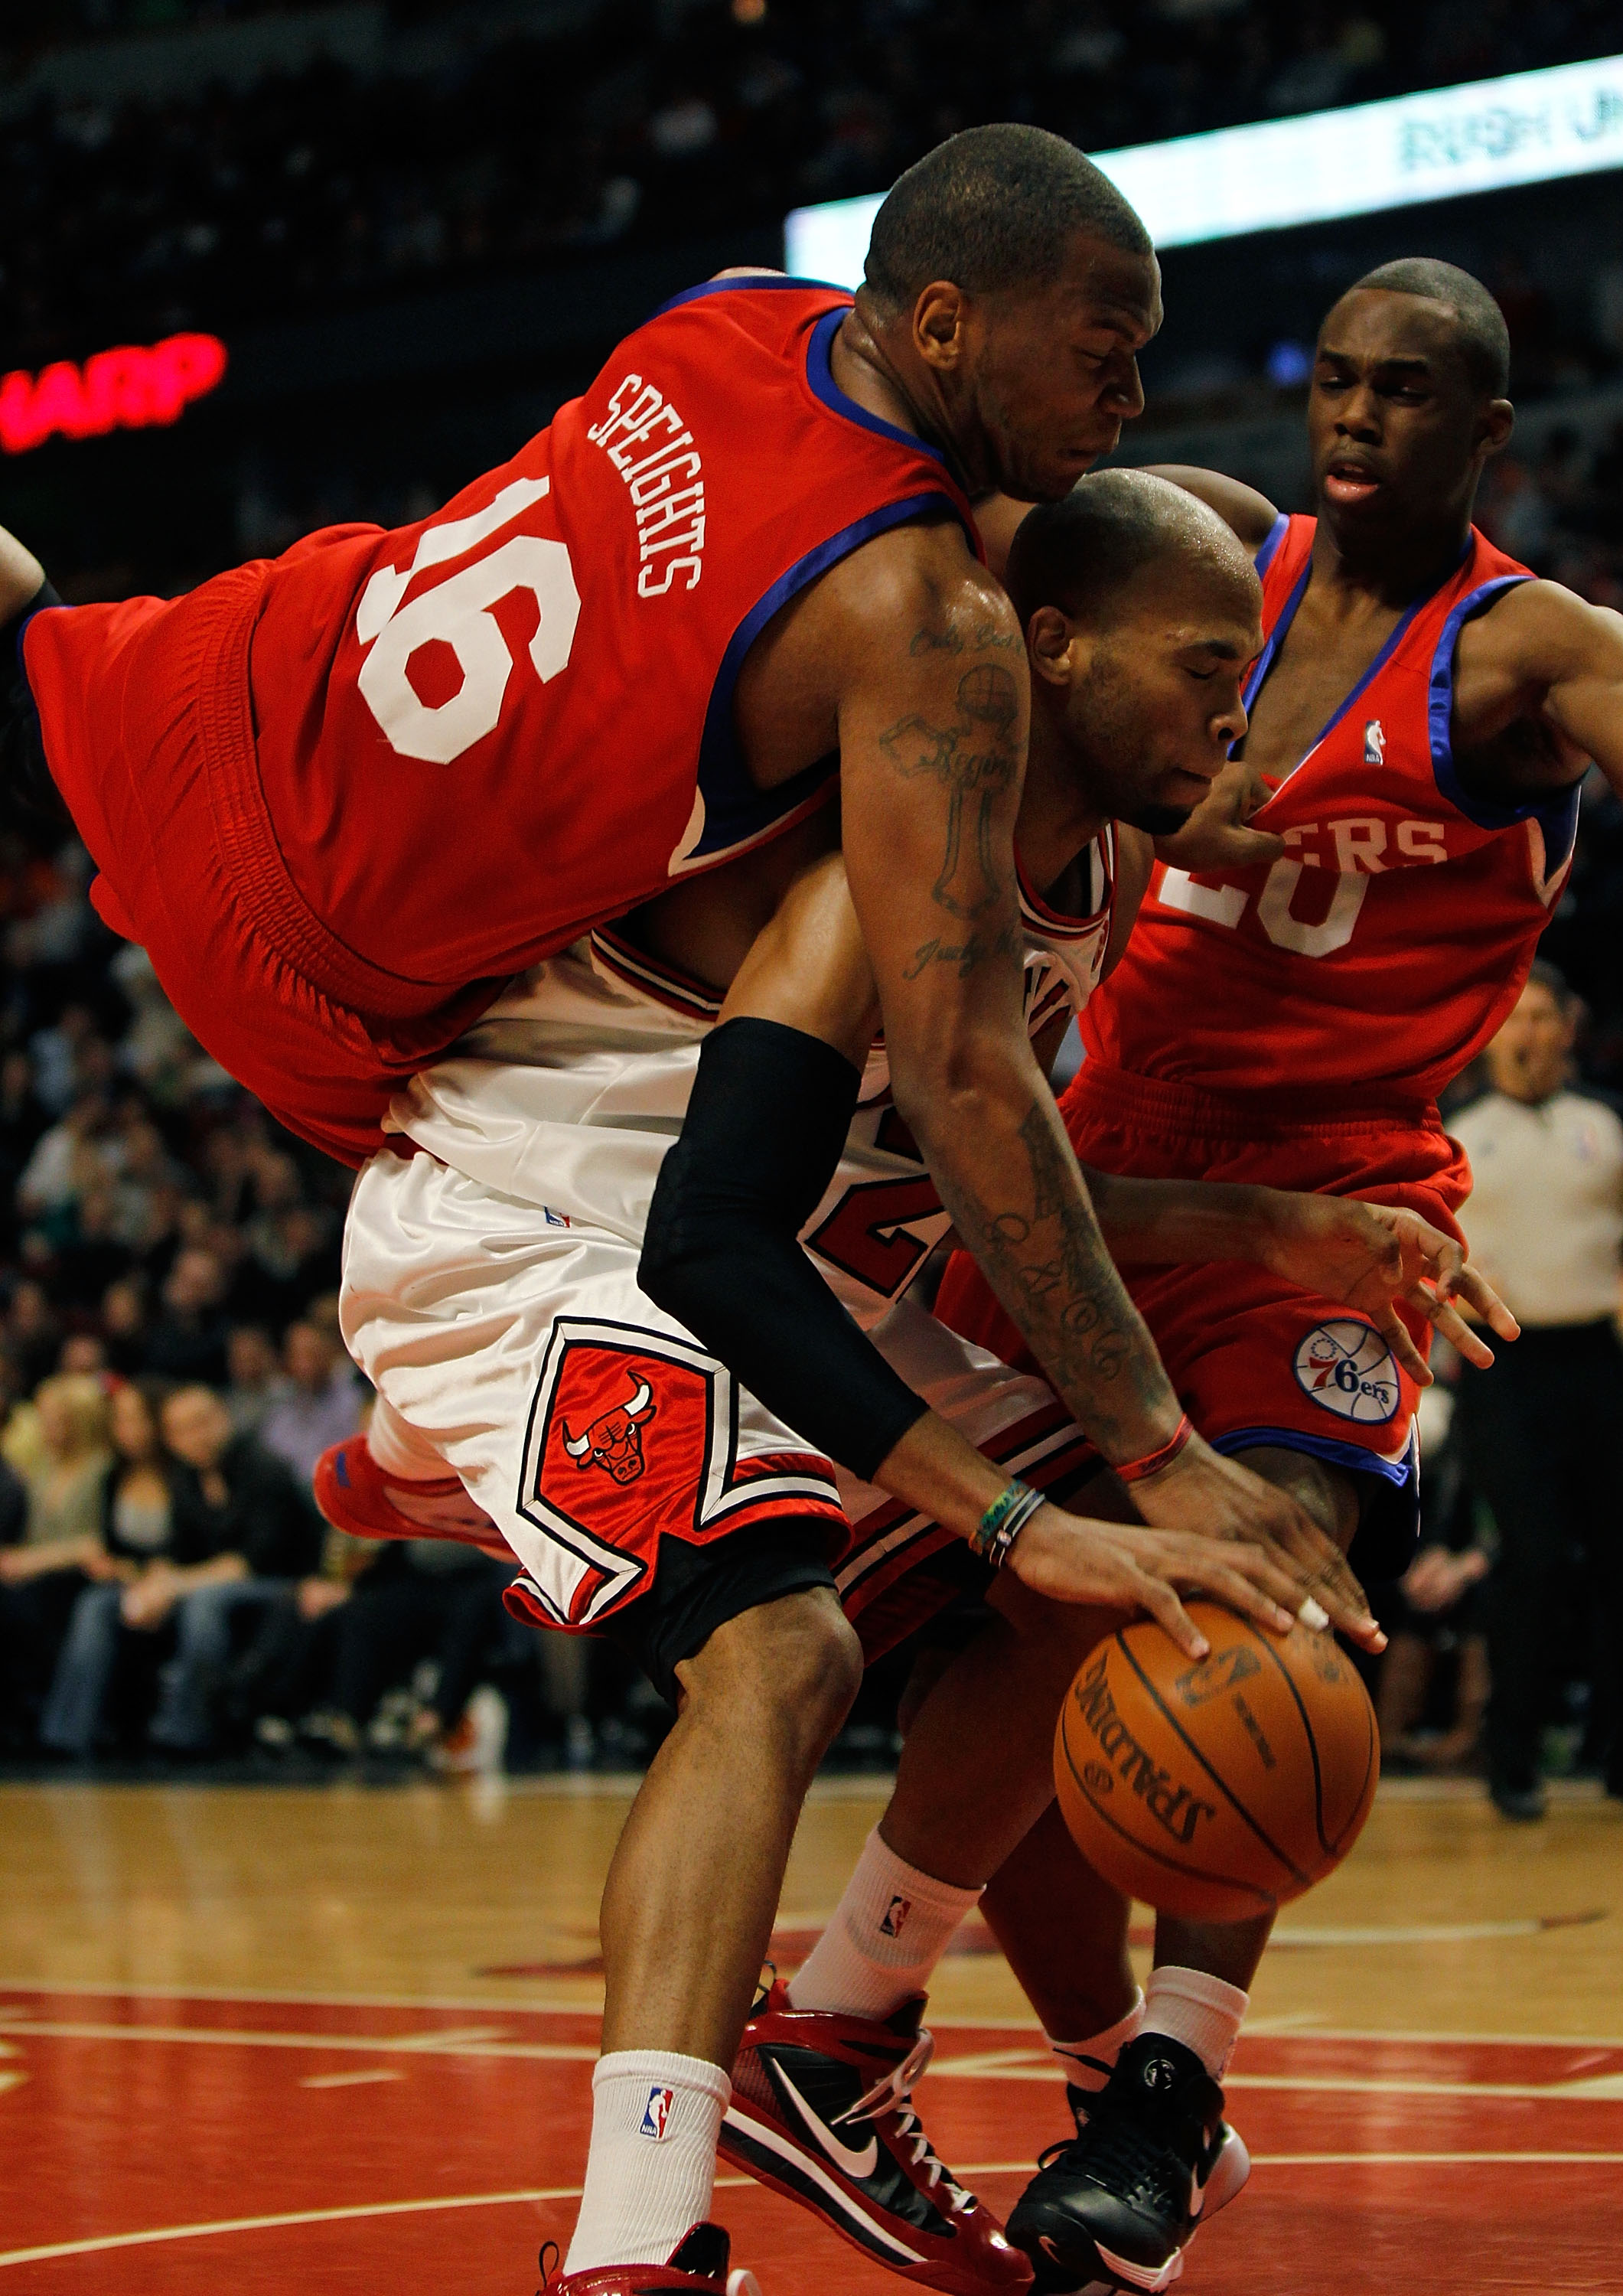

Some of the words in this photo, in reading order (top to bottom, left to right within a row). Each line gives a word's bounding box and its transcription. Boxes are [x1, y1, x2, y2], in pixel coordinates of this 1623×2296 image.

[587, 373, 706, 598] SPEIGHTS
[357, 475, 582, 765] 16
[1366, 754, 1380, 763] NBA
[1281, 817, 1449, 875] ERS
[1309, 1357, 1390, 1404] 76ers
[1074, 1647, 1217, 1844] SPALDING
